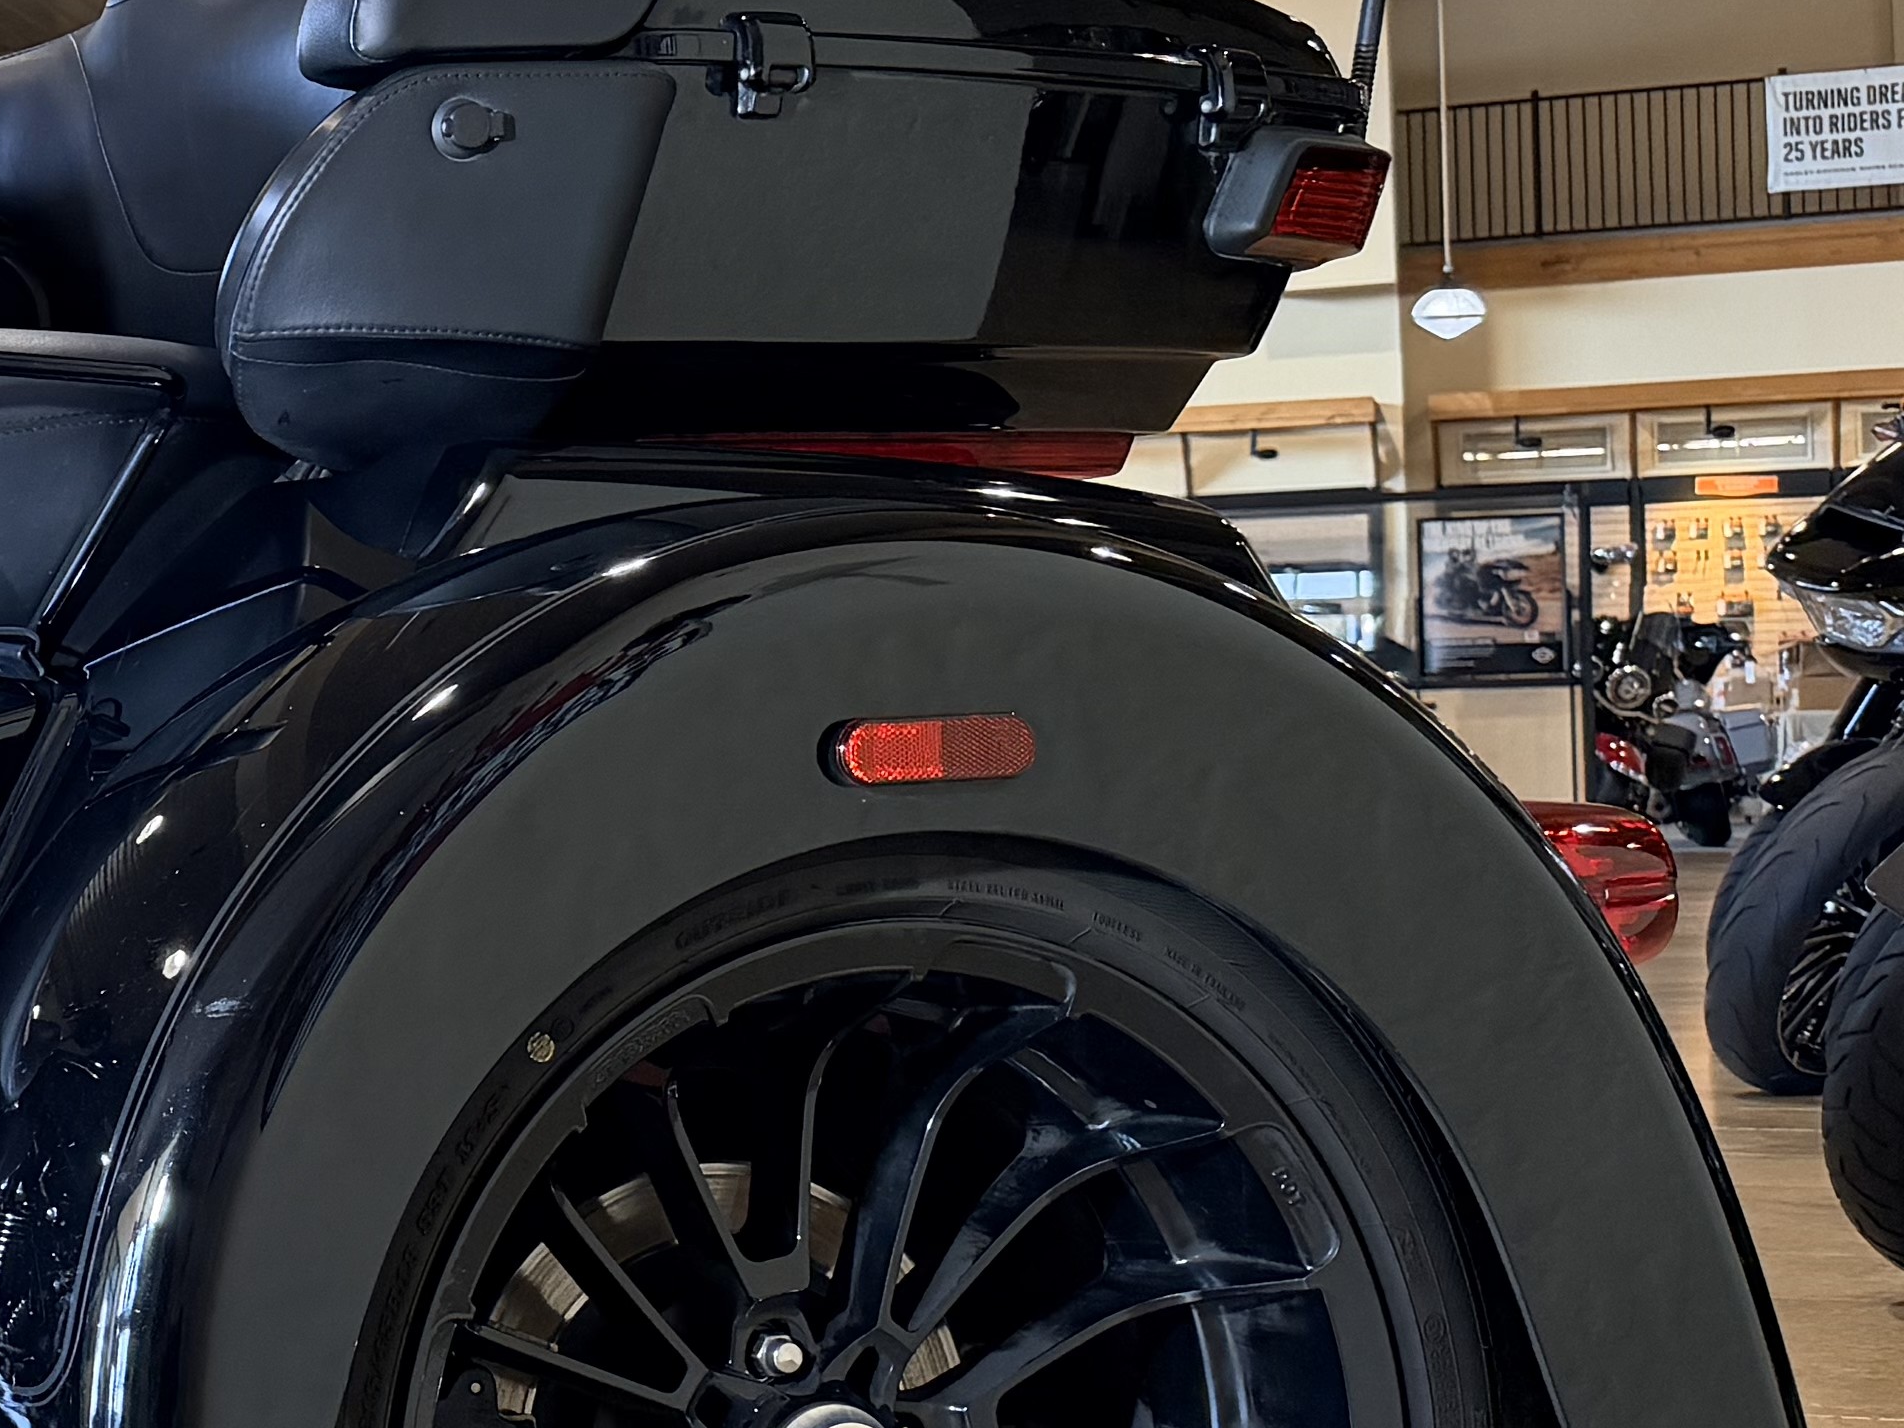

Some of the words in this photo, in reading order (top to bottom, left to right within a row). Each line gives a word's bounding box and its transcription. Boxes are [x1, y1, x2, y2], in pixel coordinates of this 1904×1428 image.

[1781, 85, 1862, 113] TURNING
[1865, 81, 1904, 106] DRE
[1783, 116, 1824, 138] INTO
[1829, 109, 1892, 134] RIDERS
[1783, 140, 1805, 163] 25
[1809, 136, 1865, 161] YEARS
